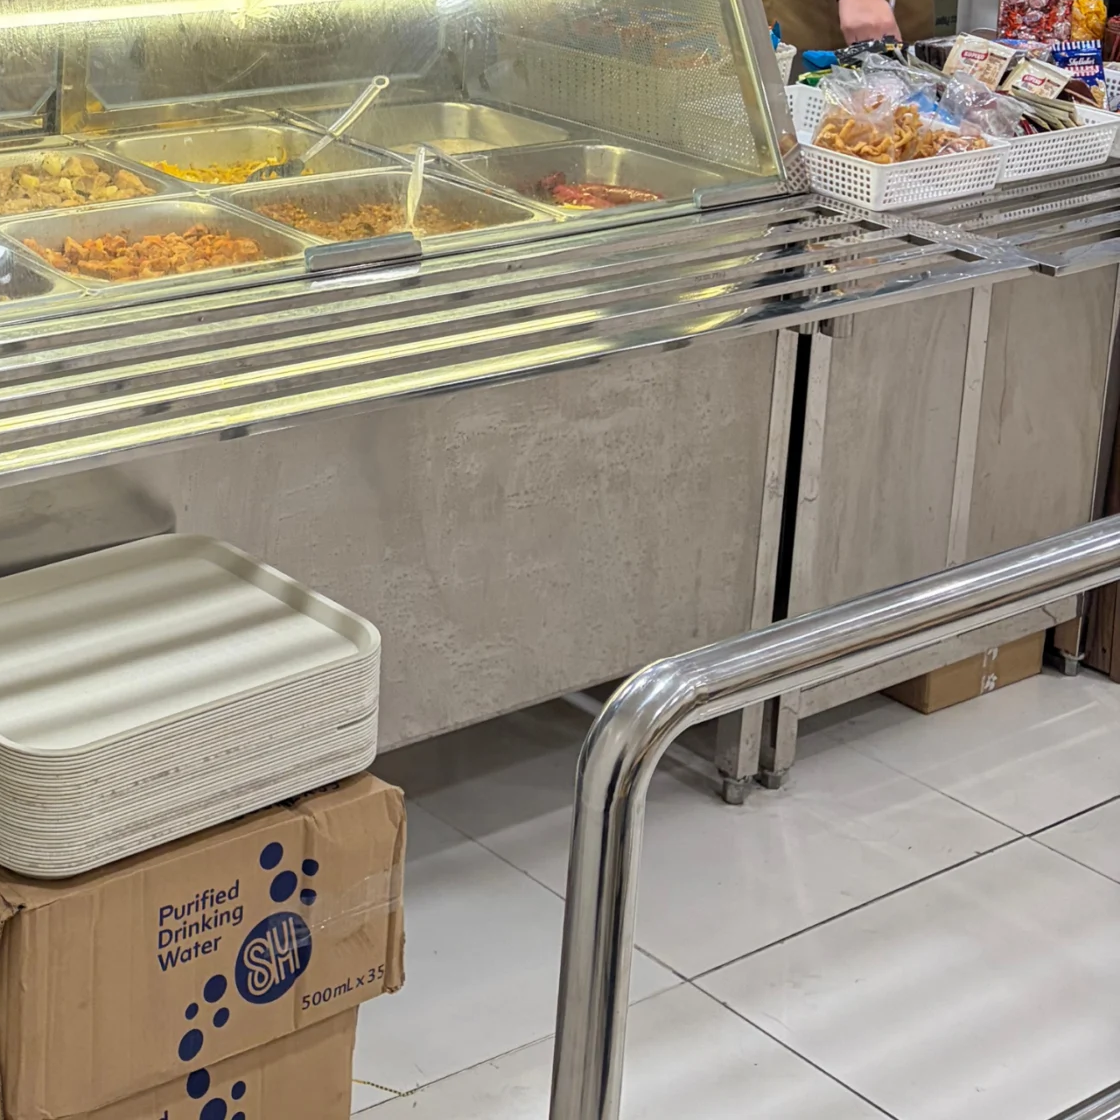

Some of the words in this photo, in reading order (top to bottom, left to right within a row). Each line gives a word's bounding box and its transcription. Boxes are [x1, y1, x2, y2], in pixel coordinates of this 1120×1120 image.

[158, 879, 239, 927] Purified
[158, 905, 244, 950] Drinking
[157, 936, 222, 972] Water
[355, 977, 365, 989] x
[368, 964, 385, 982] 35
